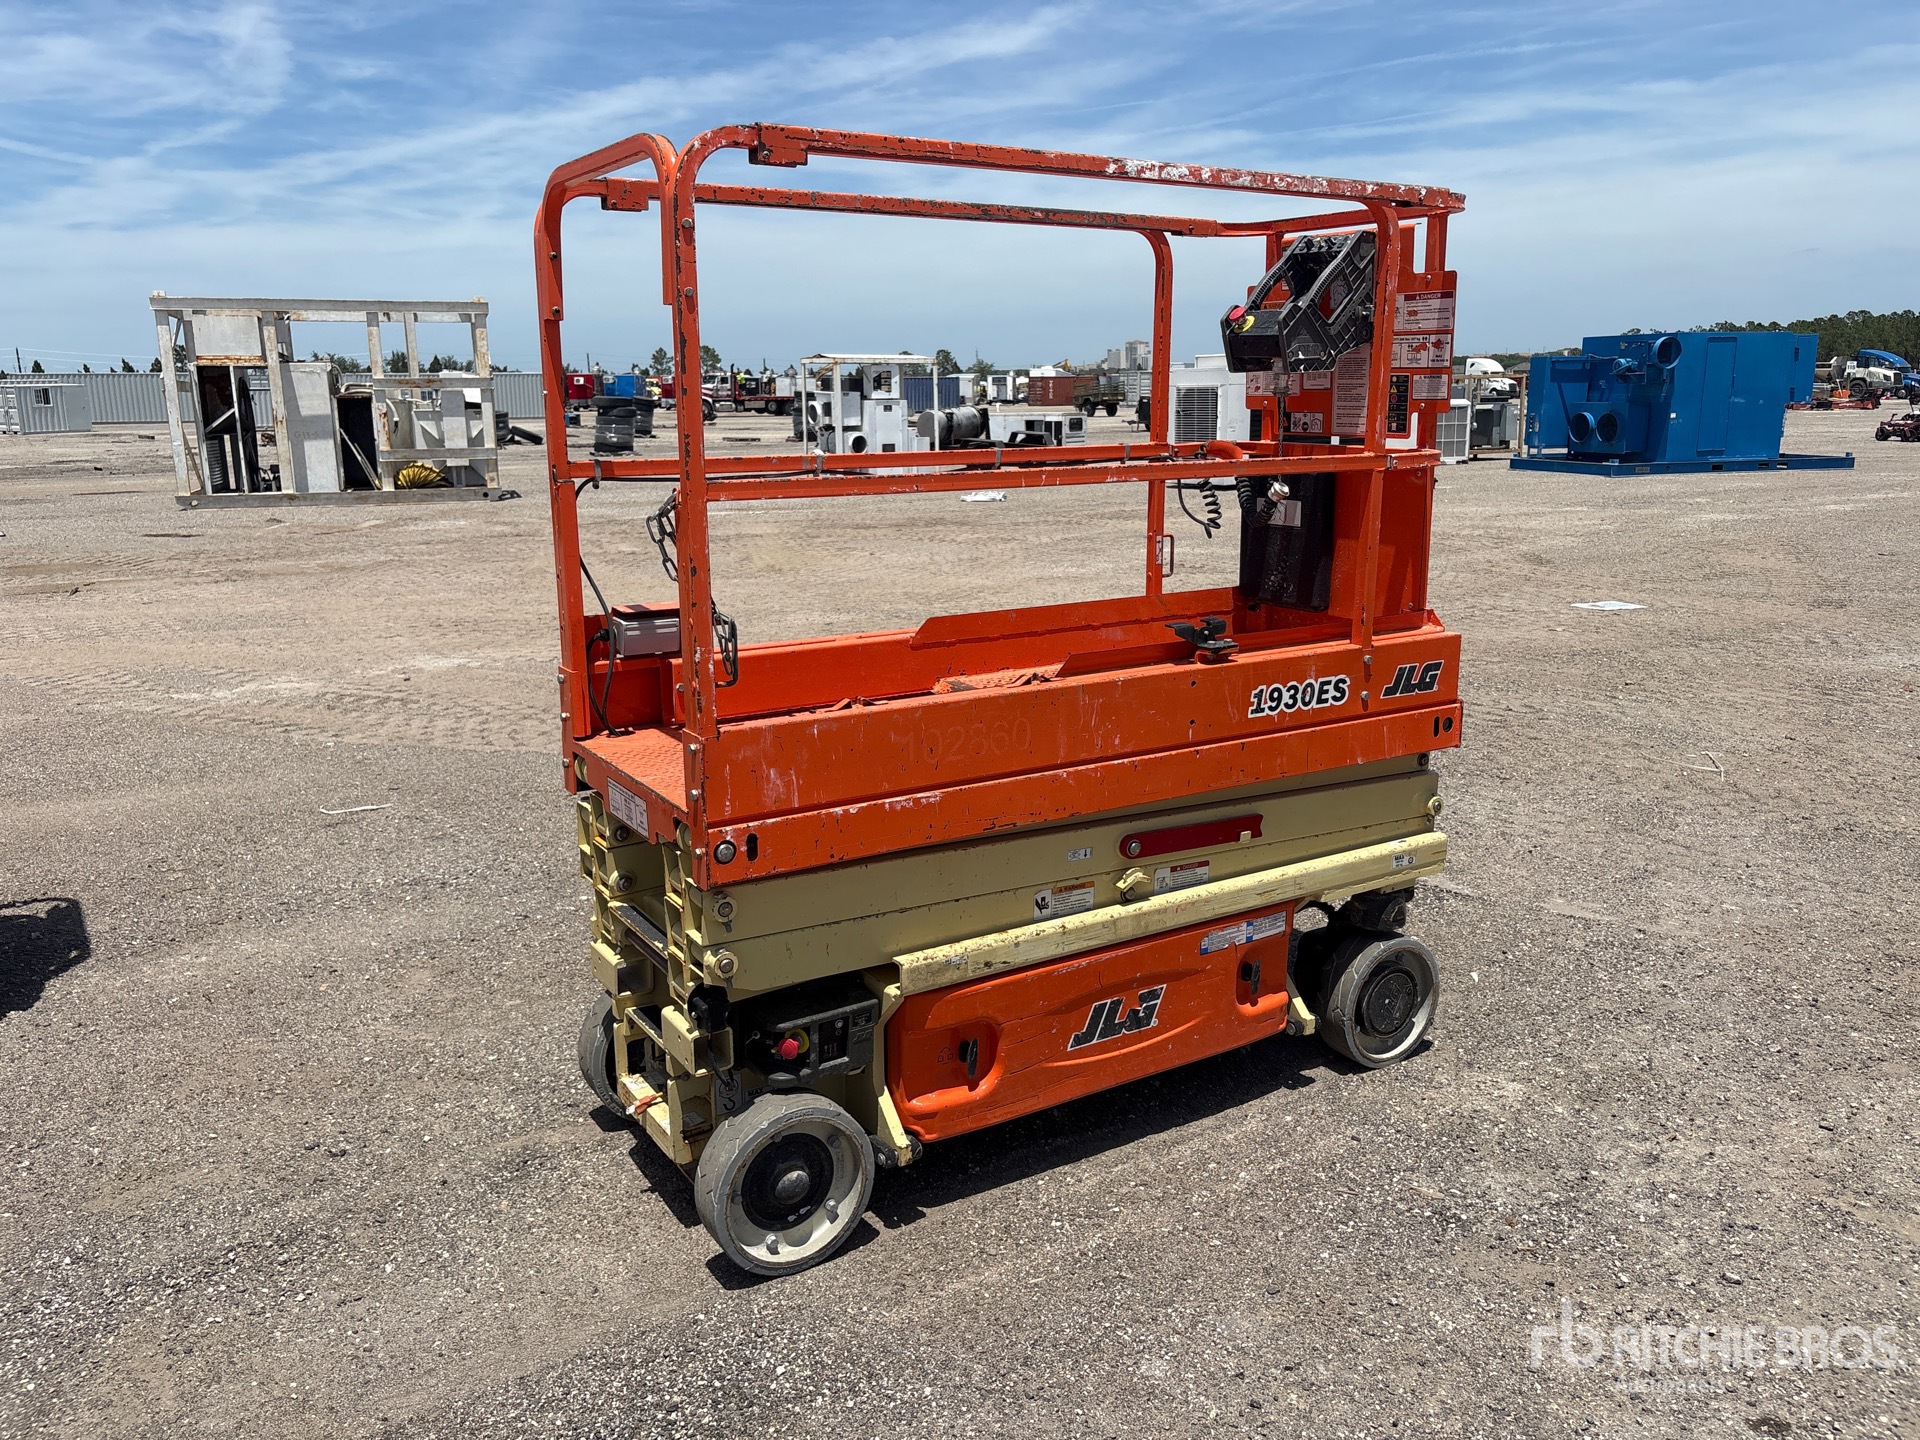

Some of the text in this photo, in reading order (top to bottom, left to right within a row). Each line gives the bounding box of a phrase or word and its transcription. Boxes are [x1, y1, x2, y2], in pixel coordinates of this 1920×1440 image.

[1249, 675, 1350, 718] 1930ES
[1381, 660, 1444, 698] JLG
[1064, 883, 1086, 892] WARNING
[1067, 984, 1167, 1051] JLG
